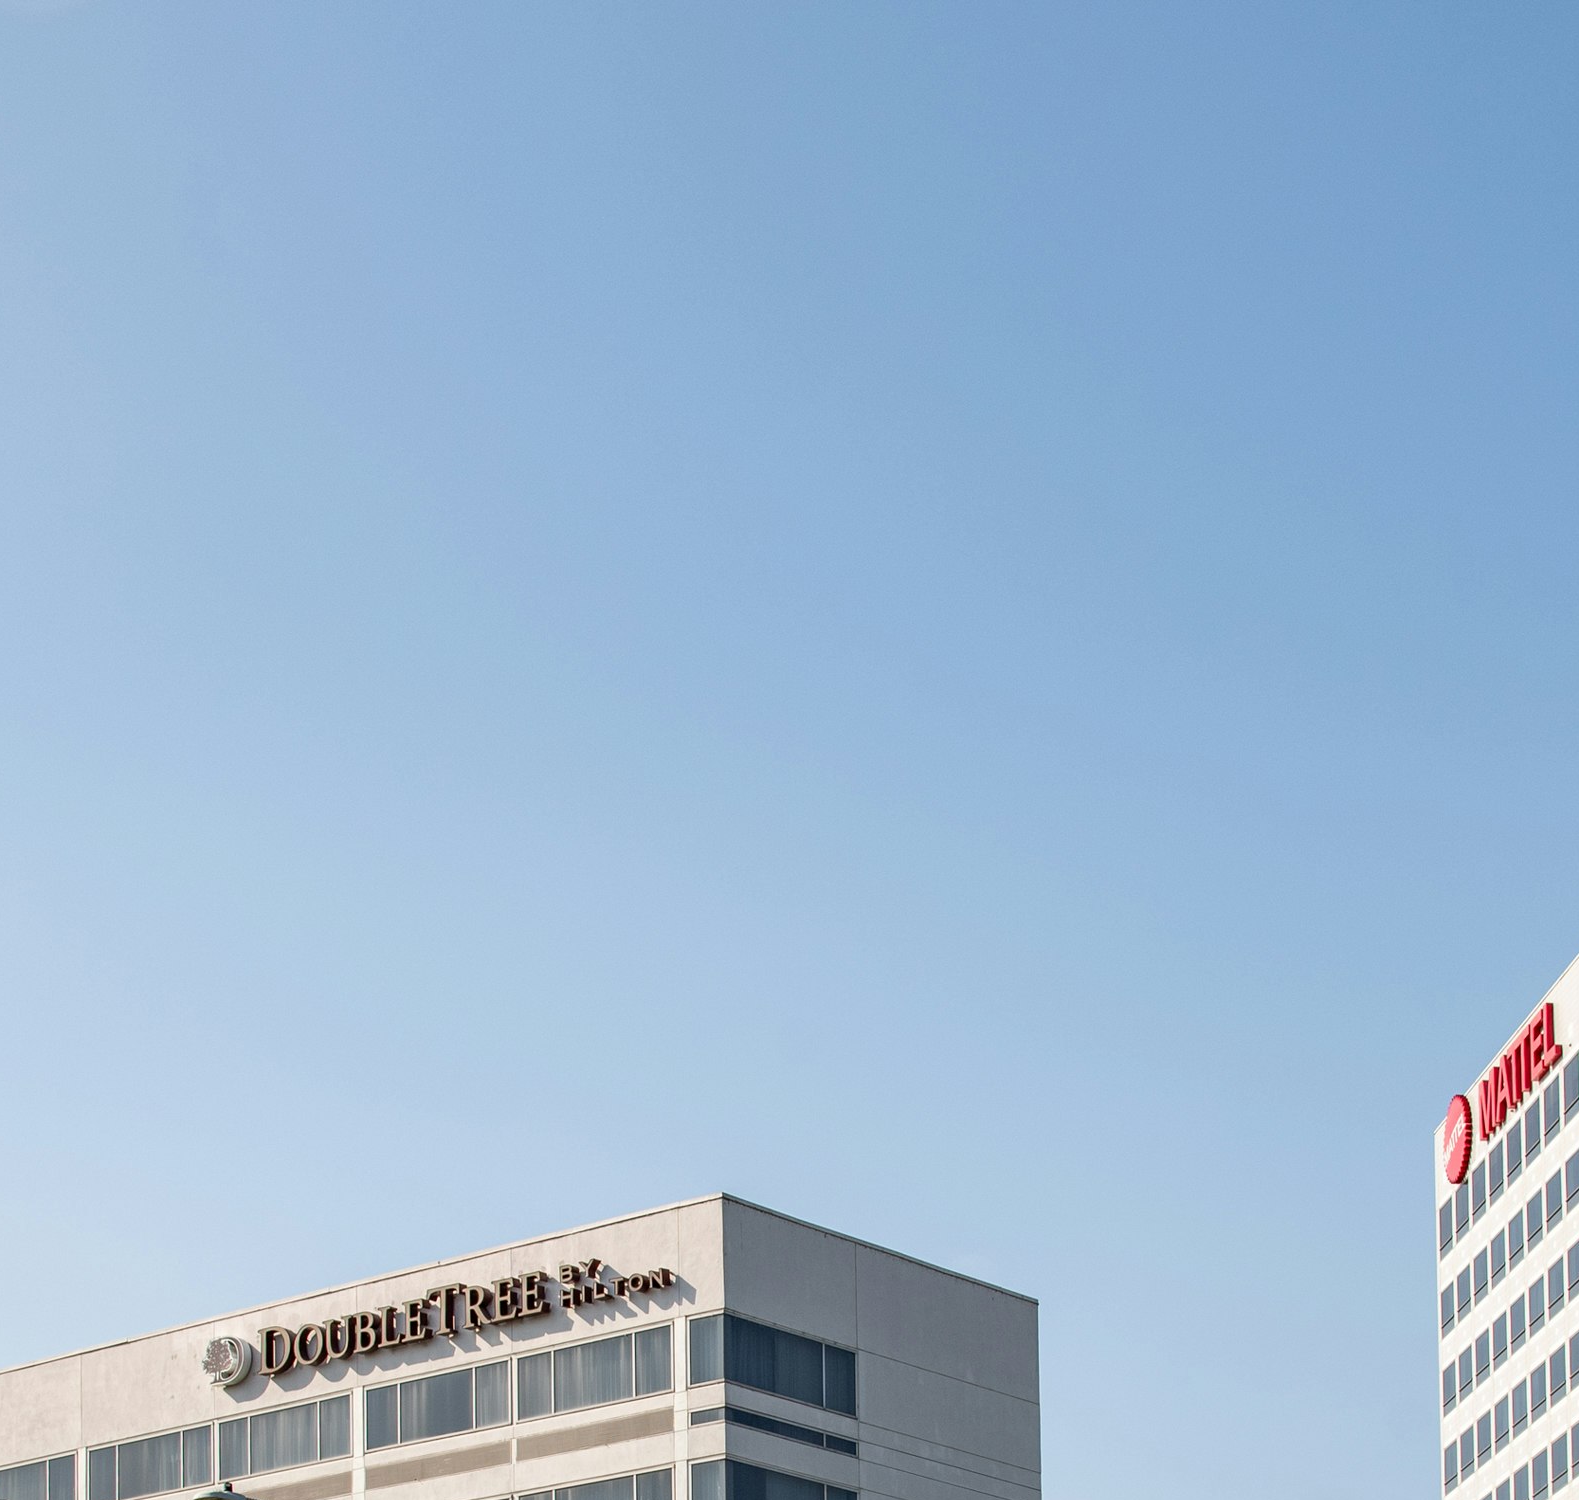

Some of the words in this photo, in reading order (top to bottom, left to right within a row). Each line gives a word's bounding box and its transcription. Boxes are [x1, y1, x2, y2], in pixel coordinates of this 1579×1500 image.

[1478, 1002, 1563, 1142] MATTEL
[559, 1258, 601, 1284] BY
[560, 1267, 673, 1308] HILTON
